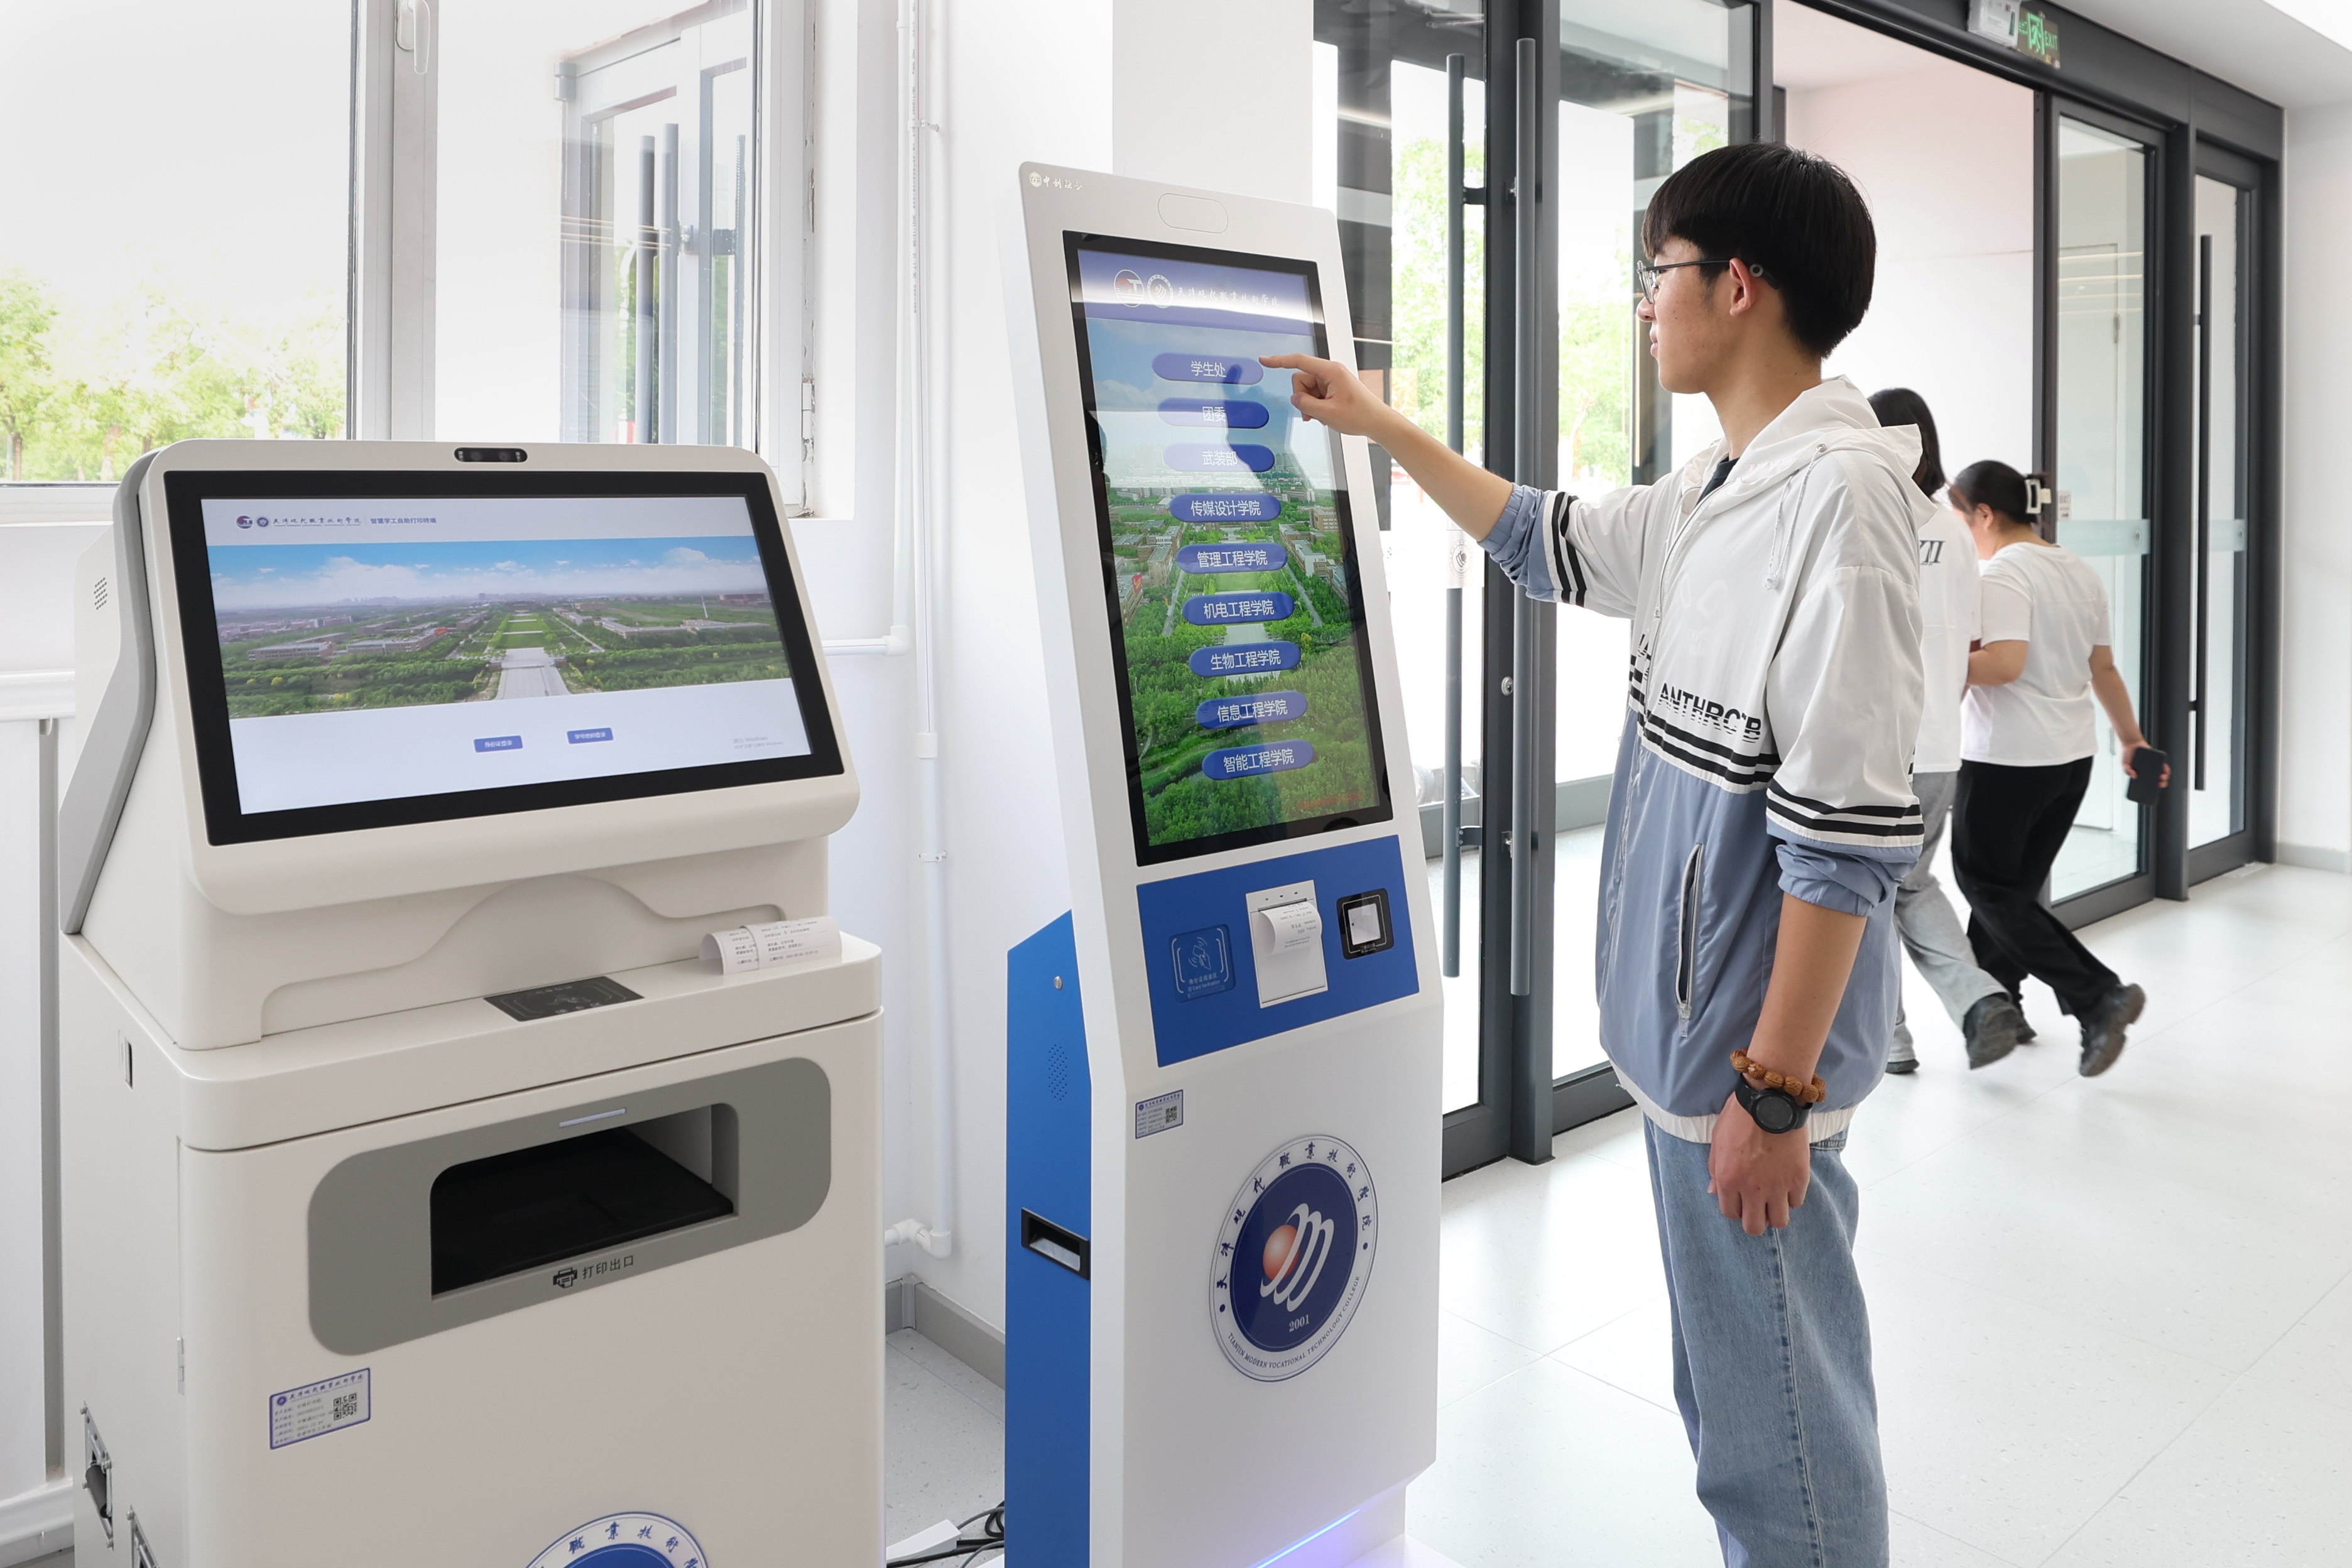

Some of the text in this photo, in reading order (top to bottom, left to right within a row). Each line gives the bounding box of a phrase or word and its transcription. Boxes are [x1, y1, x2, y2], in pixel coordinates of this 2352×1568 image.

[2044, 30, 2058, 50] EXIT
[1190, 361, 1227, 378] 学生处
[1202, 406, 1226, 422] 团委
[1202, 450, 1238, 467] 武装部
[1190, 500, 1261, 517] 传媒设计学院
[1197, 550, 1268, 569] 管理工程学院
[1203, 599, 1275, 619] 机电工程学院
[1210, 649, 1282, 670] 生物工程学院
[1217, 699, 1288, 723] 信息工程学院
[1223, 748, 1294, 773] 智能工程学院
[582, 1255, 634, 1280] 打印出口
[1228, 1276, 1360, 1369] TIANJIN MODERN VOCATIONAL TECHNOLOGY COLLEGE
[1289, 1314, 1310, 1332] 2001
